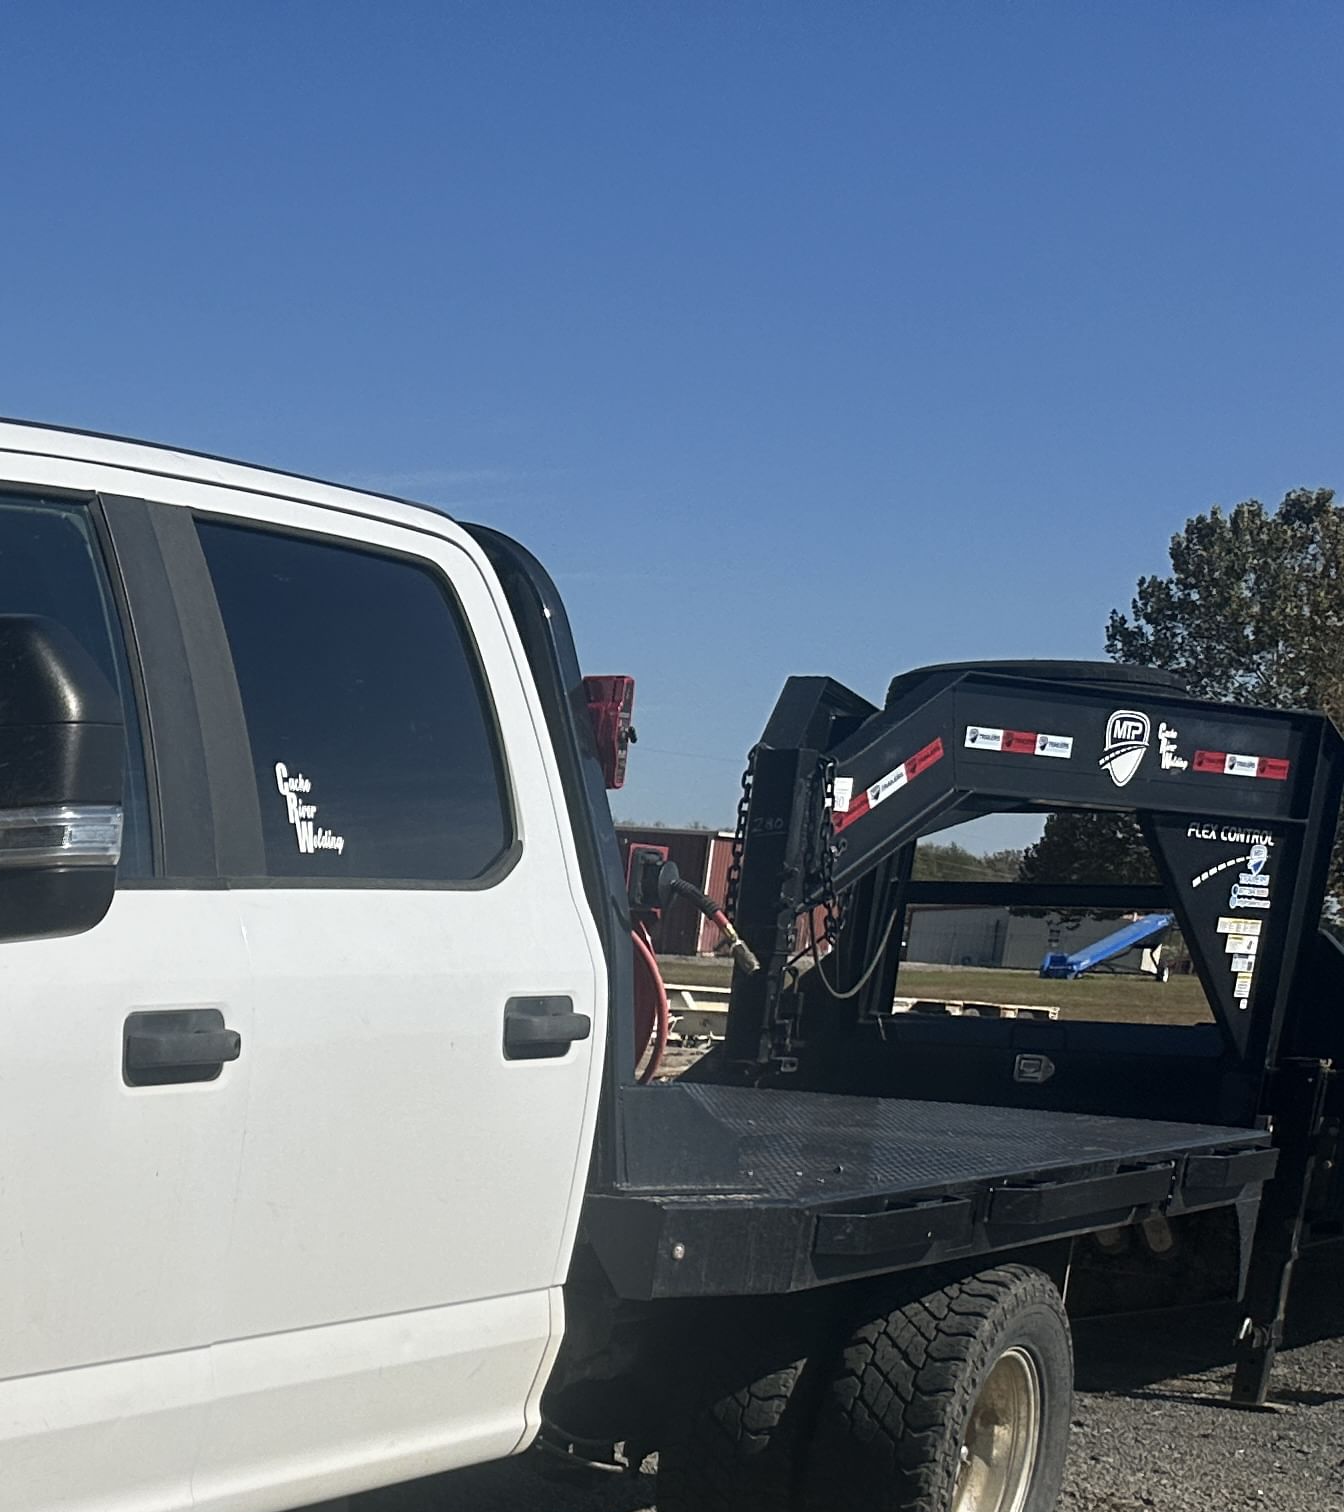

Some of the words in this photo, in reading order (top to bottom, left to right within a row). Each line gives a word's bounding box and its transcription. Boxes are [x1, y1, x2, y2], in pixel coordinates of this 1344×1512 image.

[1113, 720, 1144, 741] MTP
[286, 792, 317, 824] River
[296, 816, 345, 856] Welding
[1187, 822, 1219, 840] FLEX
[1220, 826, 1275, 847] CONTROL
